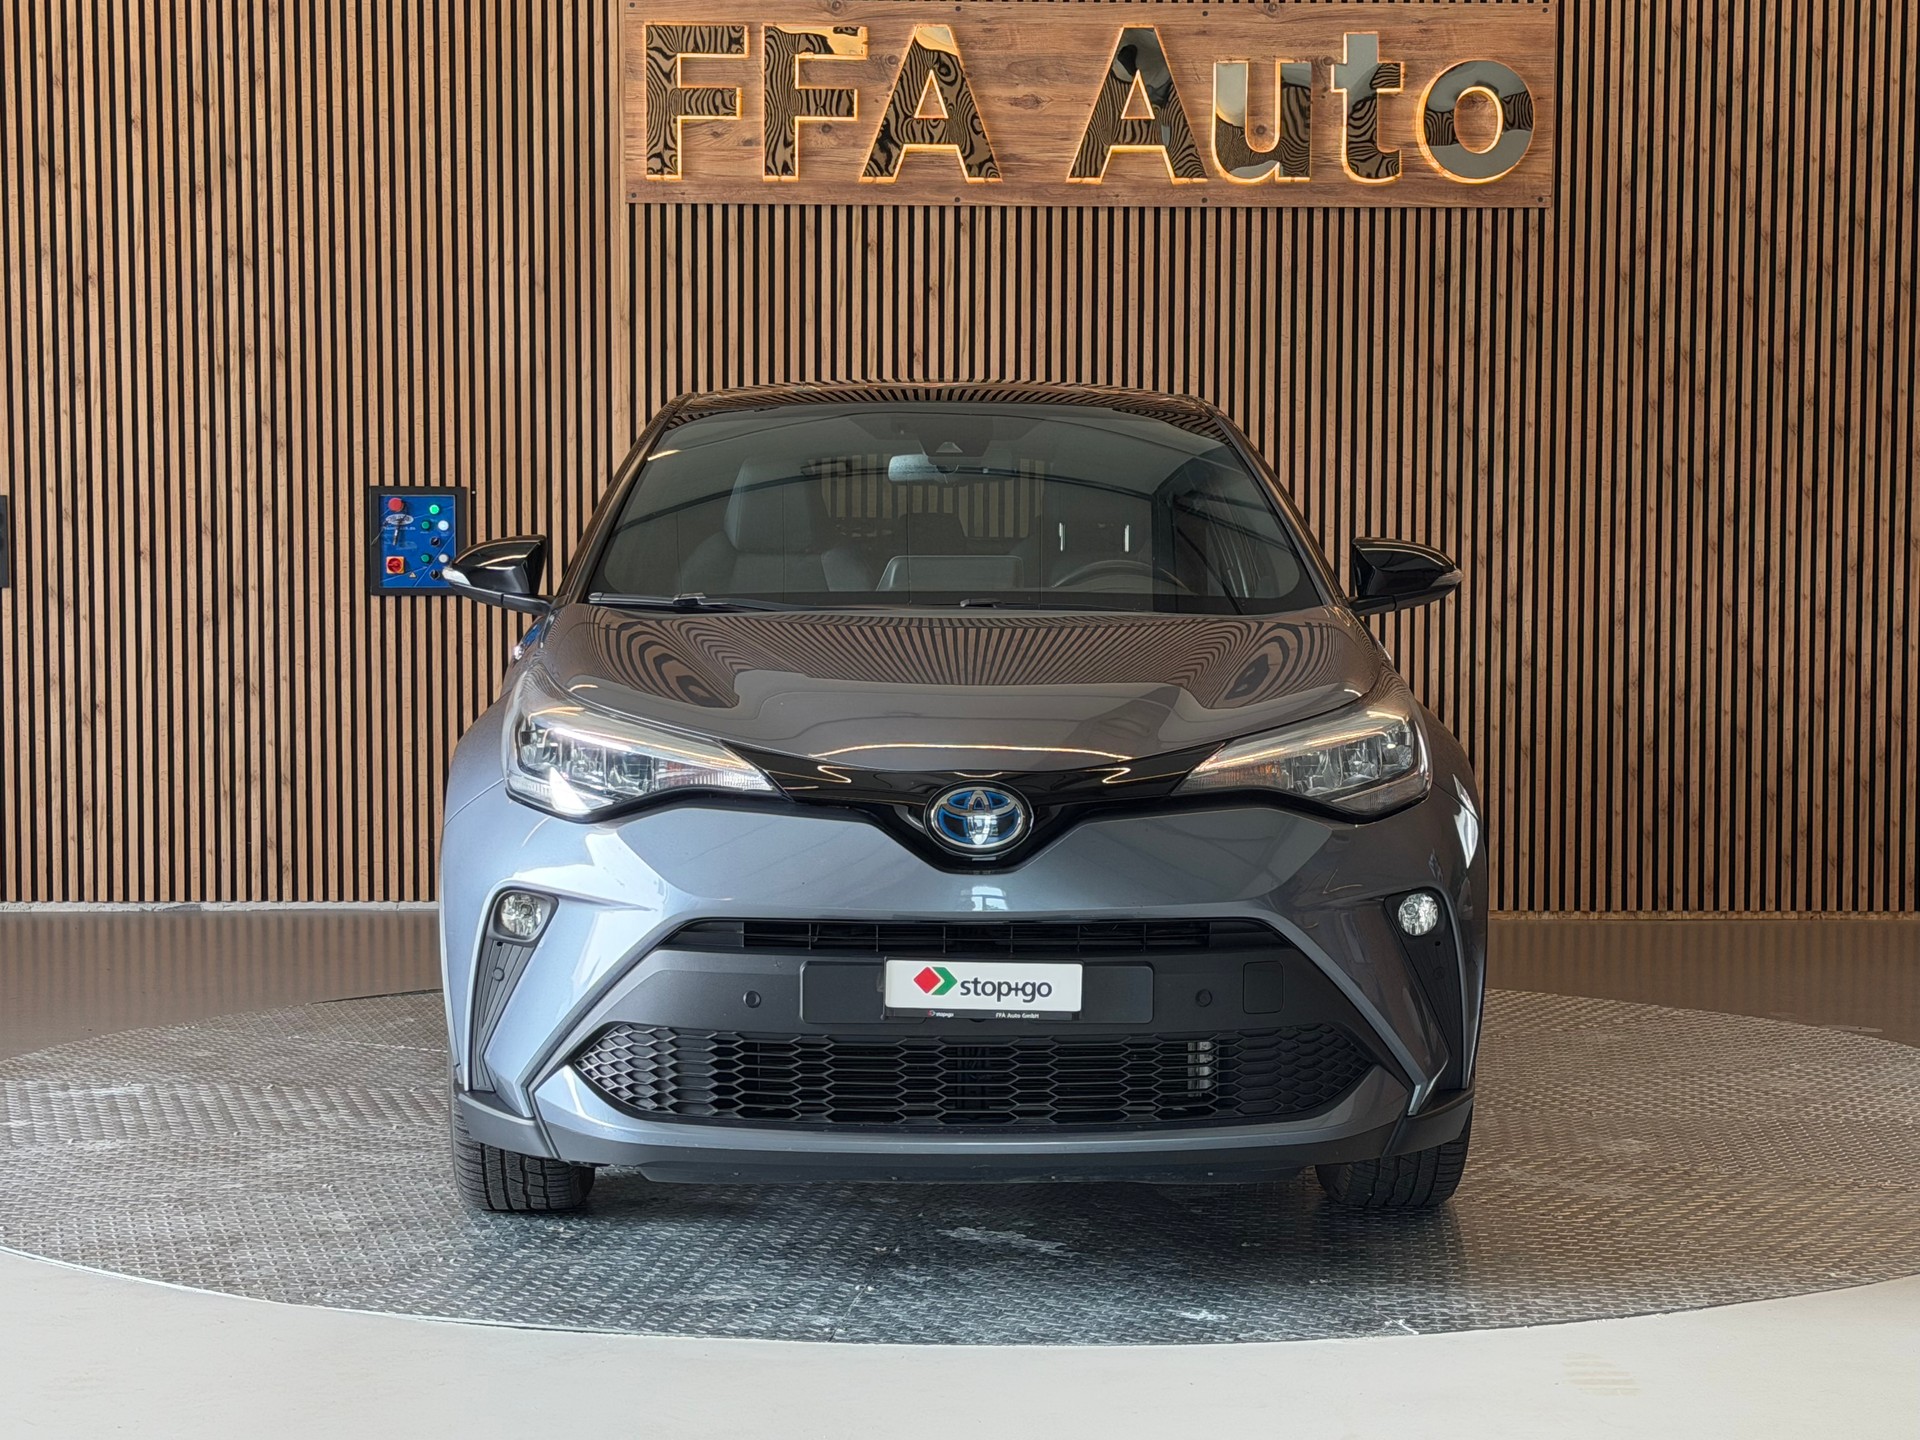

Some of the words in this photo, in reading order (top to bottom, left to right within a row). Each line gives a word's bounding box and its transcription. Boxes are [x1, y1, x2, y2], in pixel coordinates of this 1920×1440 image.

[643, 23, 1002, 184] FFA
[1066, 24, 1535, 185] Auto
[960, 977, 1053, 1003] stop+go
